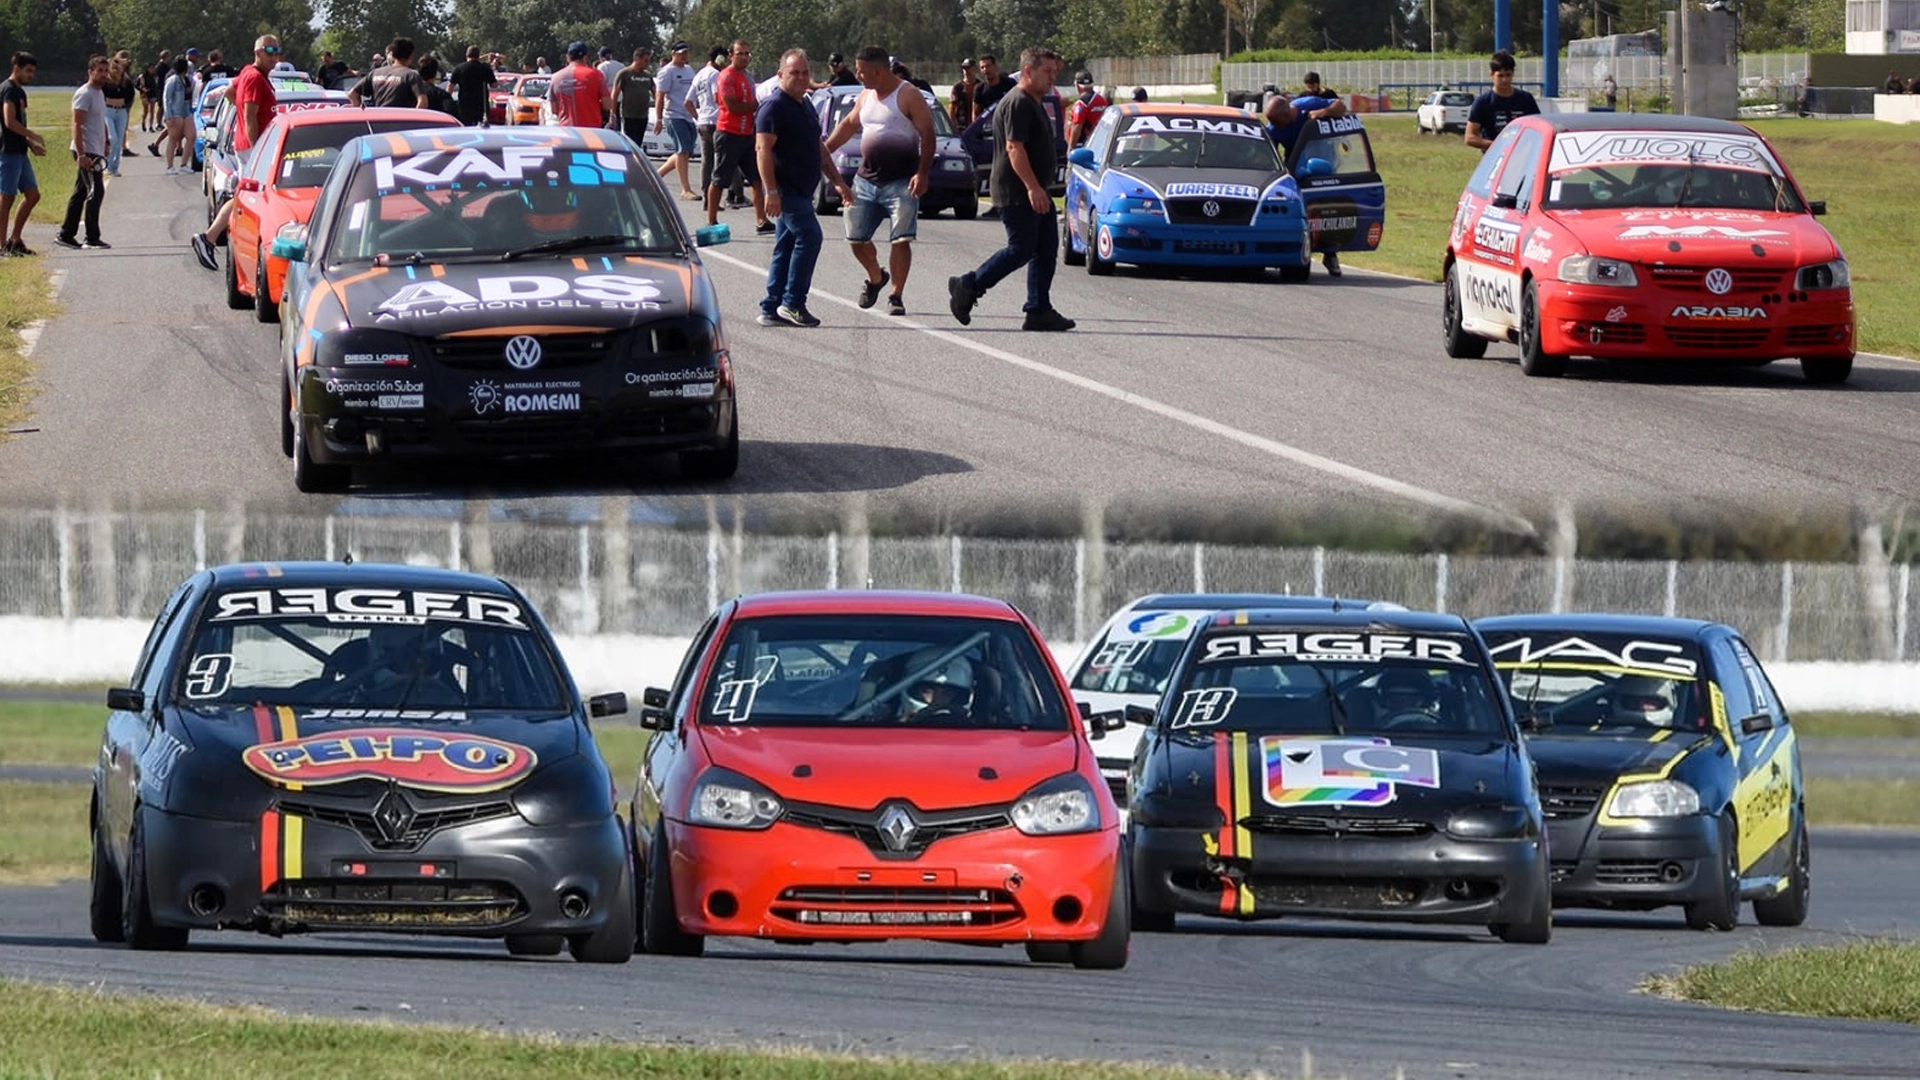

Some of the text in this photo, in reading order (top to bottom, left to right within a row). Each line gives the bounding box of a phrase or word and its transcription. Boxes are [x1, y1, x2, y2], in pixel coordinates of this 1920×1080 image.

[1127, 115, 1262, 138] ACMN
[1558, 134, 1760, 164] VUOLO
[378, 274, 662, 311] ADS
[535, 299, 591, 311] DEL
[601, 300, 661, 311] SUR
[344, 353, 409, 362] DIEGO LOPEZ
[325, 380, 394, 396] Organización
[504, 381, 543, 390] MATERIALES
[625, 368, 696, 386] Organización
[504, 393, 580, 412] ROMEMI
[185, 652, 235, 700] 3
[1171, 687, 1238, 730] 13
[257, 735, 518, 774] PEI-PO
[1343, 746, 1411, 774] C
